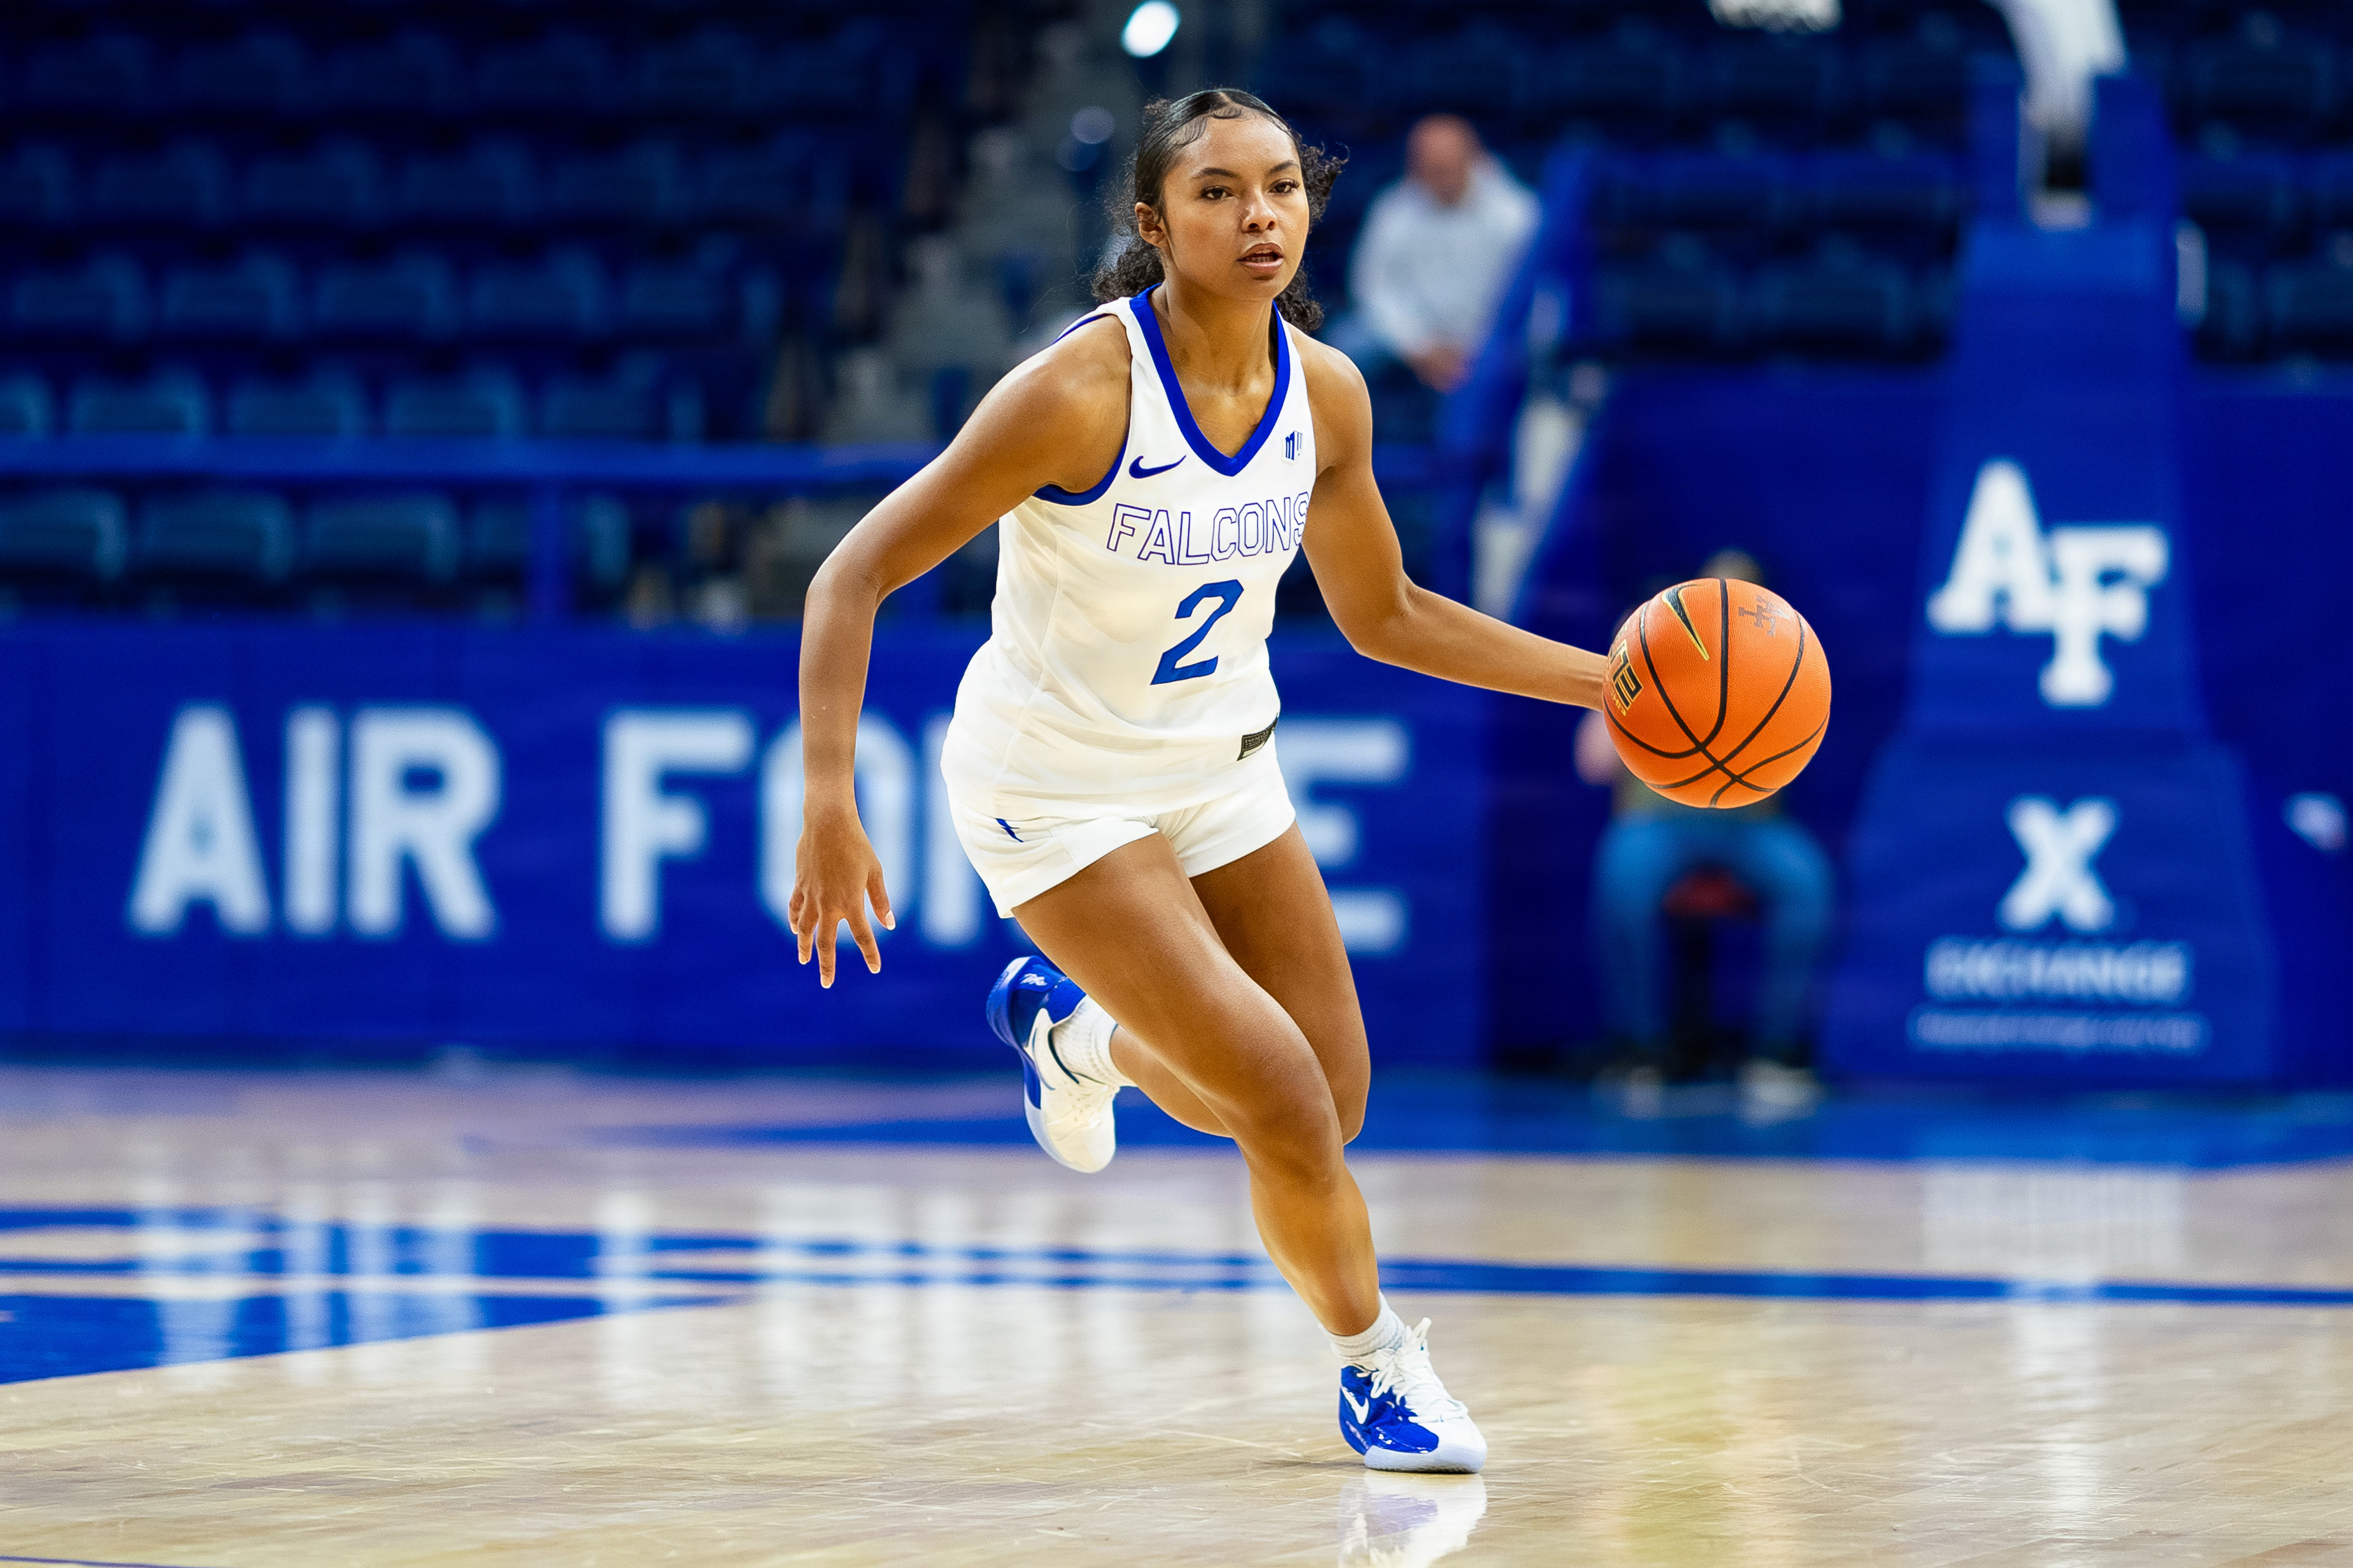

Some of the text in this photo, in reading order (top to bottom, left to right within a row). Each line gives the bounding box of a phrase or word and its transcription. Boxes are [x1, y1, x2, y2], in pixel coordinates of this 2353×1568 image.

[1107, 491, 1310, 565] FALCONS
[1927, 459, 2170, 706] AF
[1150, 579, 1244, 685] 2
[132, 708, 1408, 950] AIR FOE
